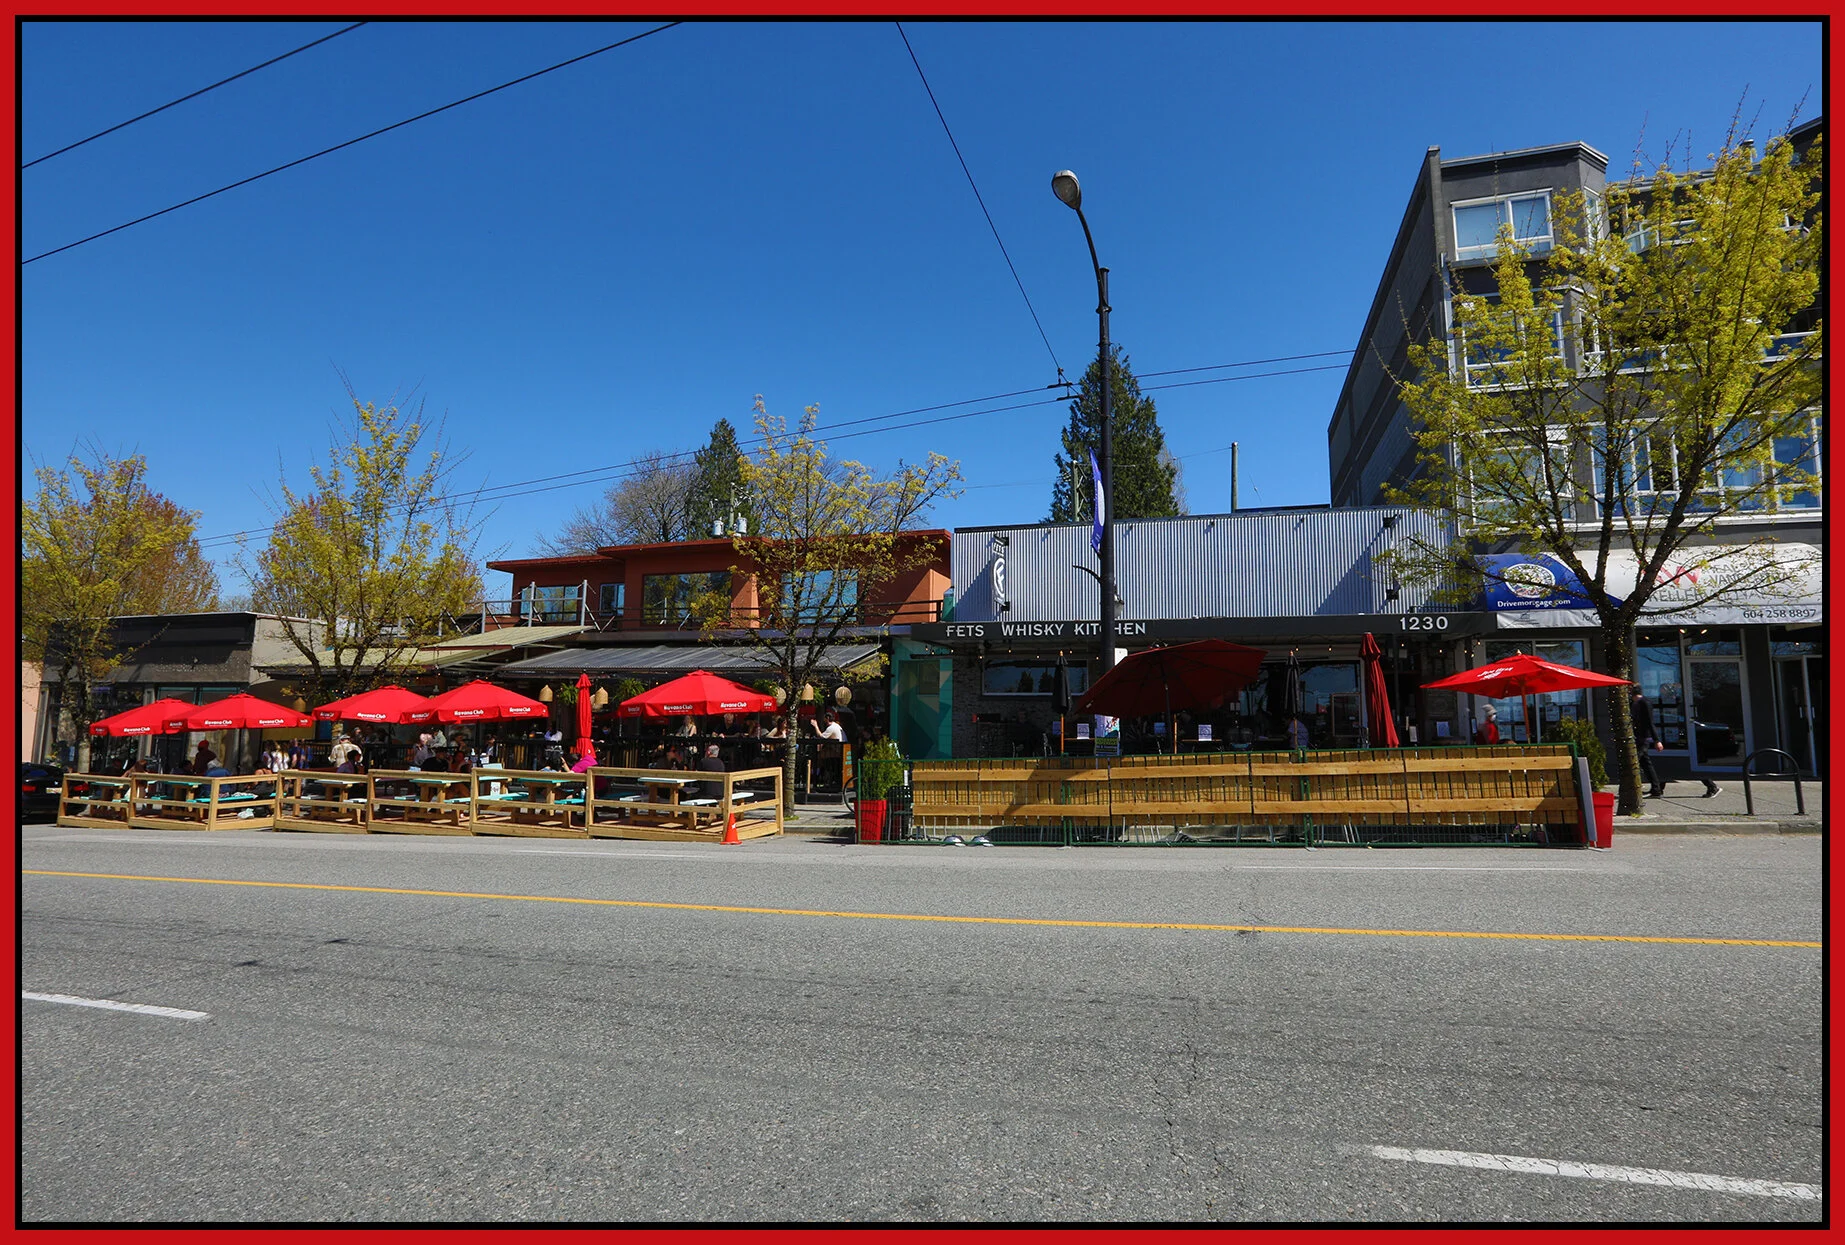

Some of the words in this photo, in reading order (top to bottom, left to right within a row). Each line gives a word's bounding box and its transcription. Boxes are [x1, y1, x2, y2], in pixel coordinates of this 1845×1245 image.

[1743, 610, 1764, 619] 604
[1766, 609, 1787, 618] 258
[1789, 609, 1817, 618] 8897
[946, 625, 985, 638] FETS
[1002, 623, 1065, 637] WHISKY
[1074, 622, 1146, 636] KITHEN
[1400, 616, 1449, 631] 1230
